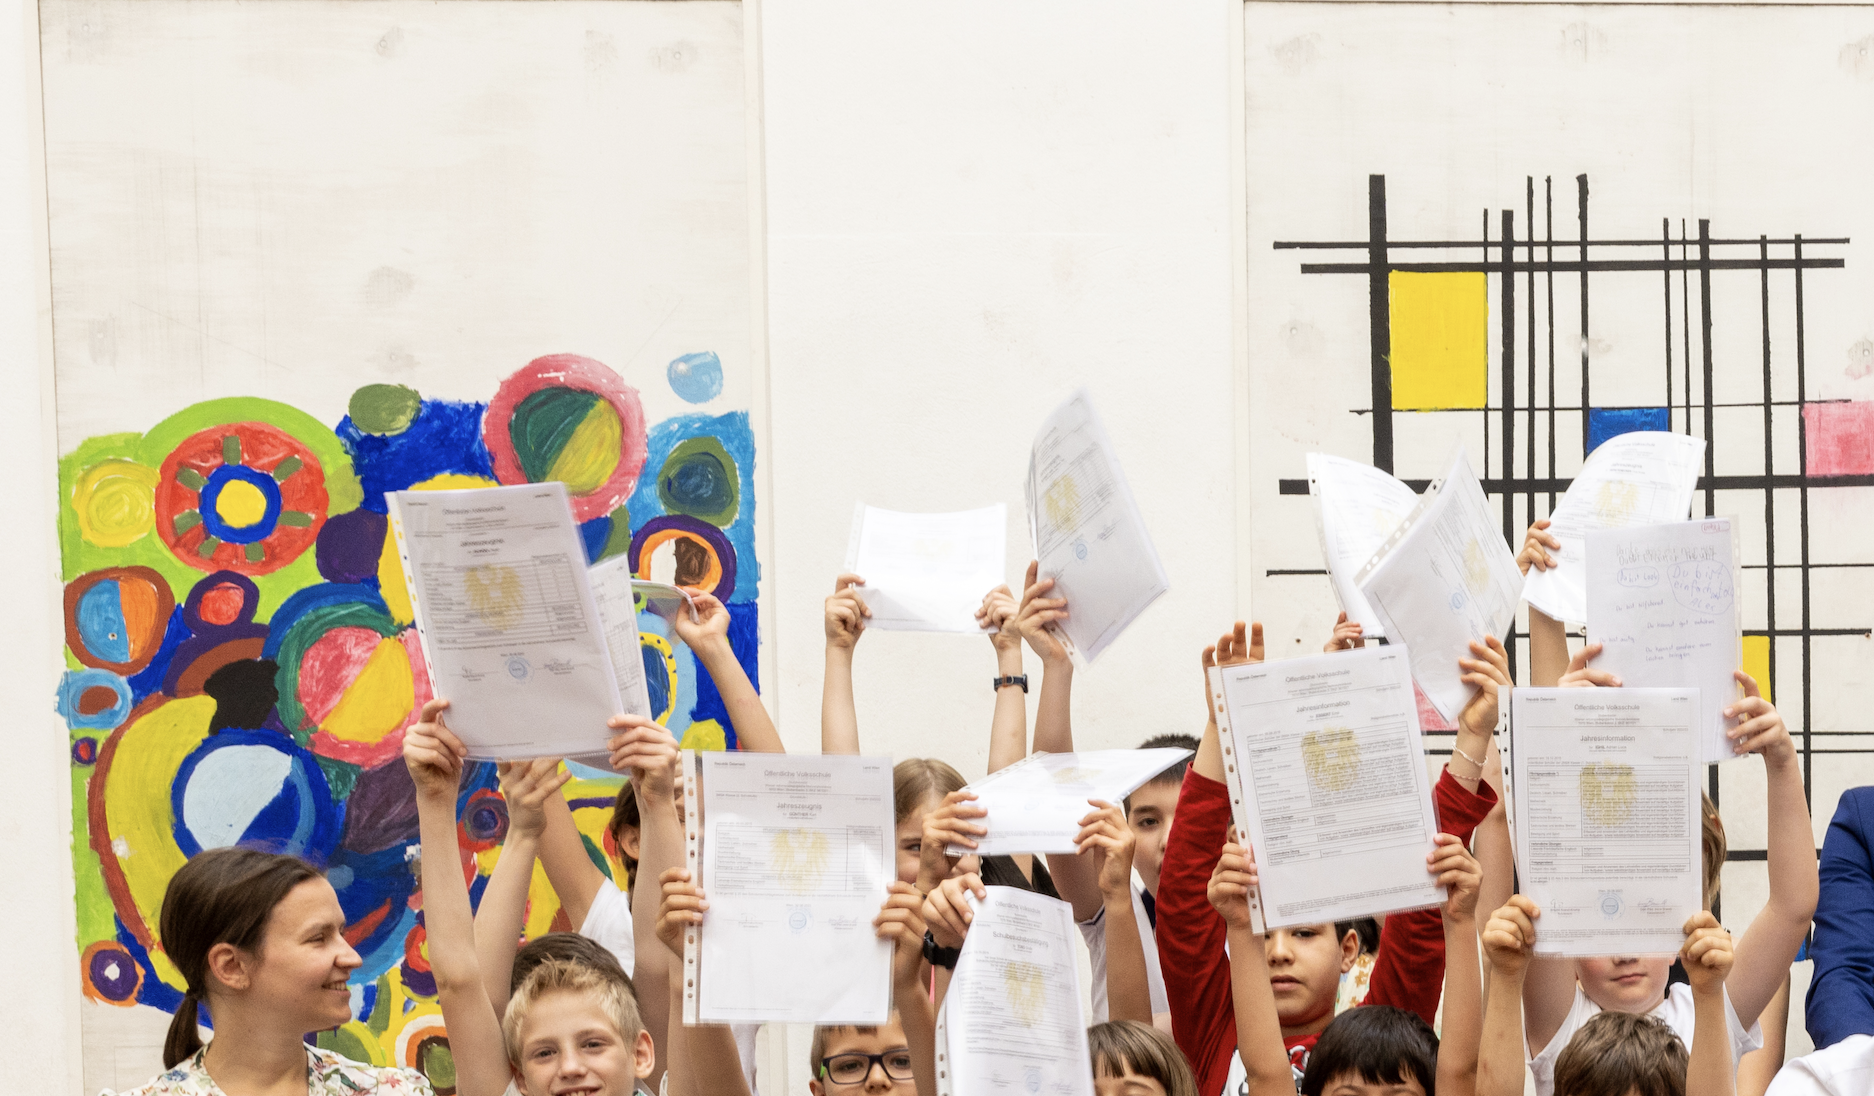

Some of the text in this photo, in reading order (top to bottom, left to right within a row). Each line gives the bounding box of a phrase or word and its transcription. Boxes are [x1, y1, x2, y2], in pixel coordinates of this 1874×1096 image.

[1285, 669, 1350, 683] Öffentliche Volksschule
[1296, 700, 1351, 713] Jahresinformation
[1574, 703, 1605, 711] Öffentliche
[764, 770, 832, 778] Öffentliche Volksschule
[776, 802, 823, 811] Jahreszeugnis
